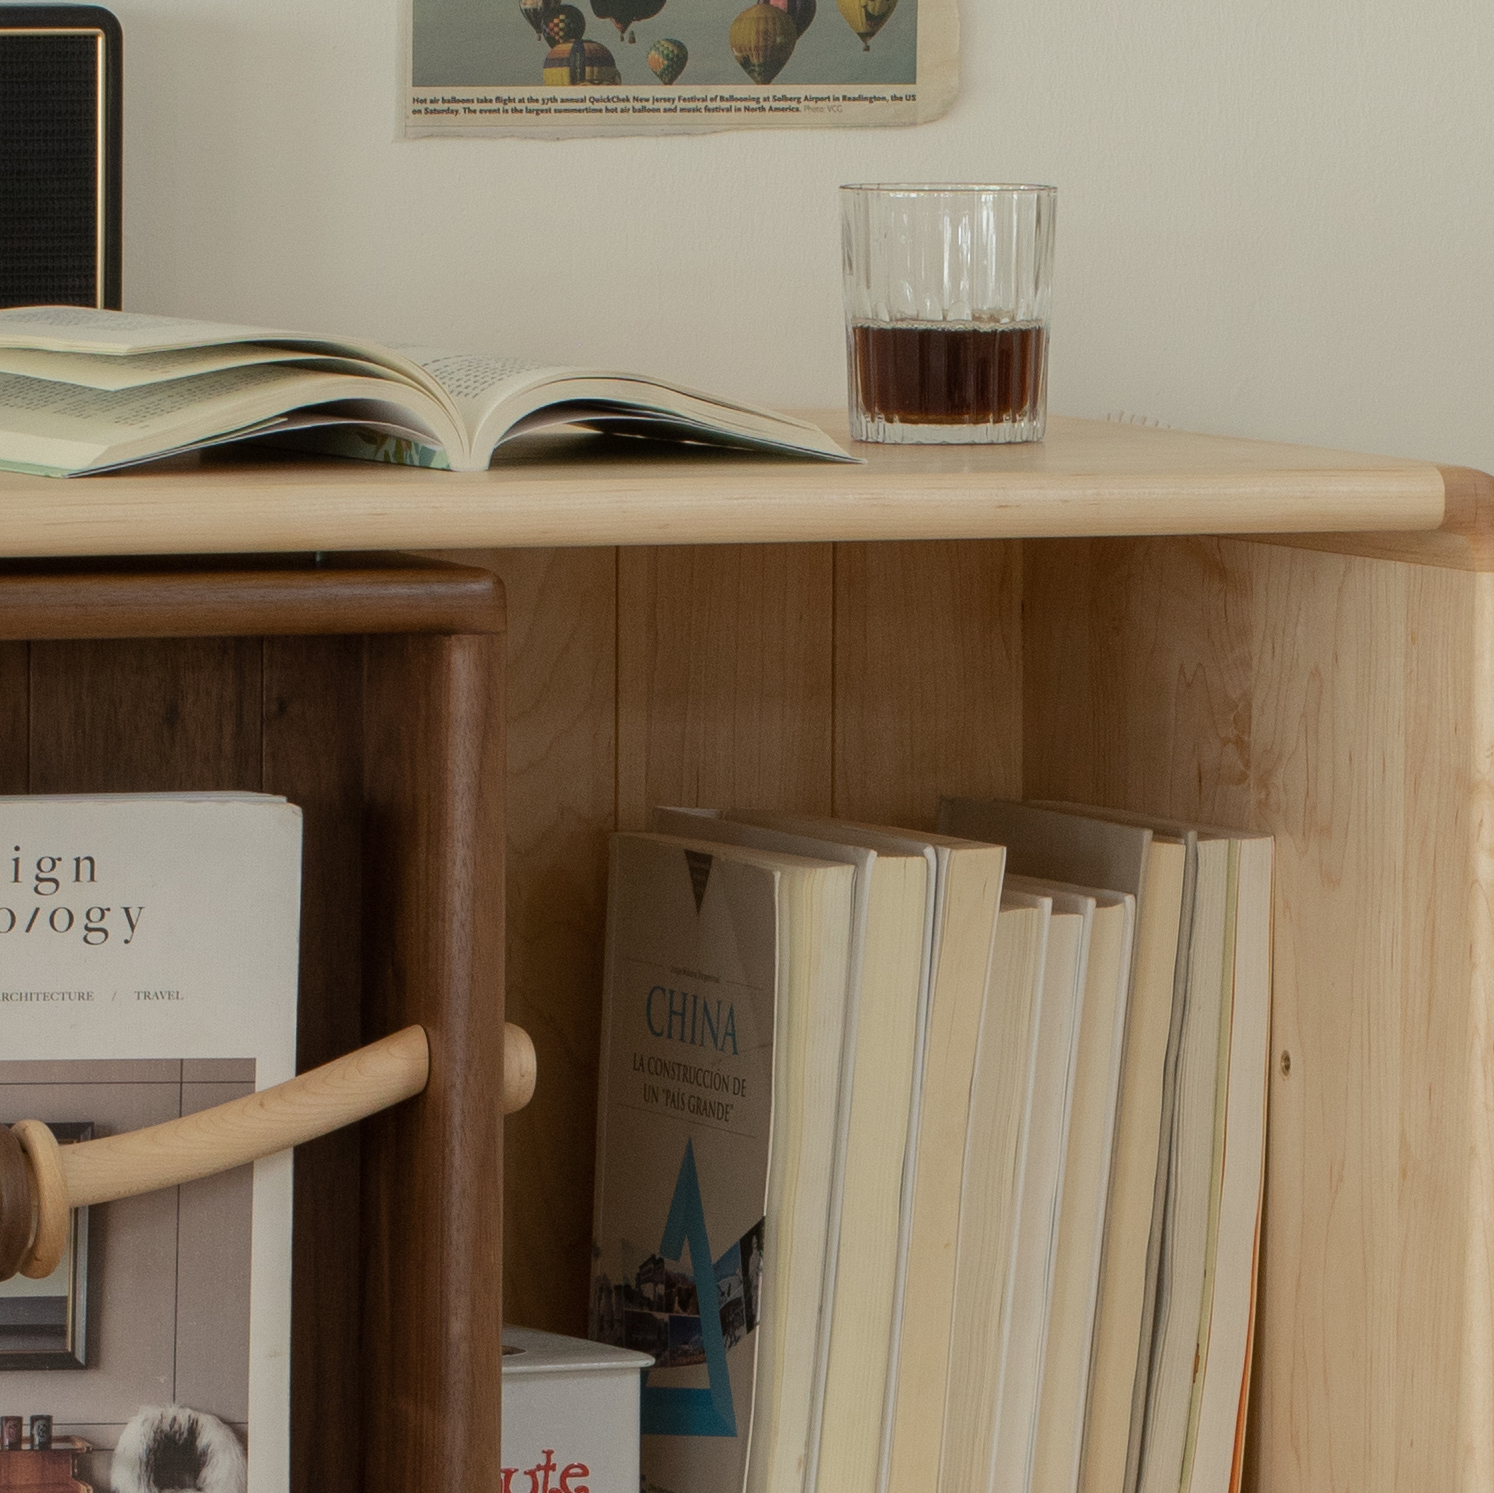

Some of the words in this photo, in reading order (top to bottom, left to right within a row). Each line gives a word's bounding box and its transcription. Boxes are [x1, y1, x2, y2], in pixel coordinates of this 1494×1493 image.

[412, 96, 427, 104] Hot
[429, 96, 440, 104] air
[441, 96, 475, 104] balloons
[476, 96, 493, 104] take
[495, 95, 516, 106] flight
[527, 95, 539, 104] the
[560, 95, 587, 104] annual
[633, 95, 650, 103] New
[652, 95, 676, 105] Jersey
[677, 94, 707, 103] Festival
[709, 94, 719, 103] of
[719, 94, 761, 104] Ballooning
[803, 94, 831, 104] Airport
[833, 94, 840, 102] in
[891, 94, 903, 102] the
[905, 94, 917, 102] US
[424, 107, 461, 117] Saturday.
[511, 106, 523, 114] the
[525, 106, 552, 116] largest
[605, 106, 618, 114] hot
[620, 106, 631, 114] air
[632, 106, 661, 114] balloon
[704, 105, 733, 113] festival
[734, 105, 742, 113] in
[743, 105, 767, 113] North
[768, 105, 802, 113] America.
[826, 105, 843, 113] VCG
[134, 990, 185, 1001] TRAVEL
[645, 986, 739, 1055] CHINA
[632, 1052, 646, 1073] LA
[647, 1056, 730, 1094] CONSTRUCCIÓN
[733, 1077, 747, 1097] DE
[643, 1082, 659, 1104] UN
